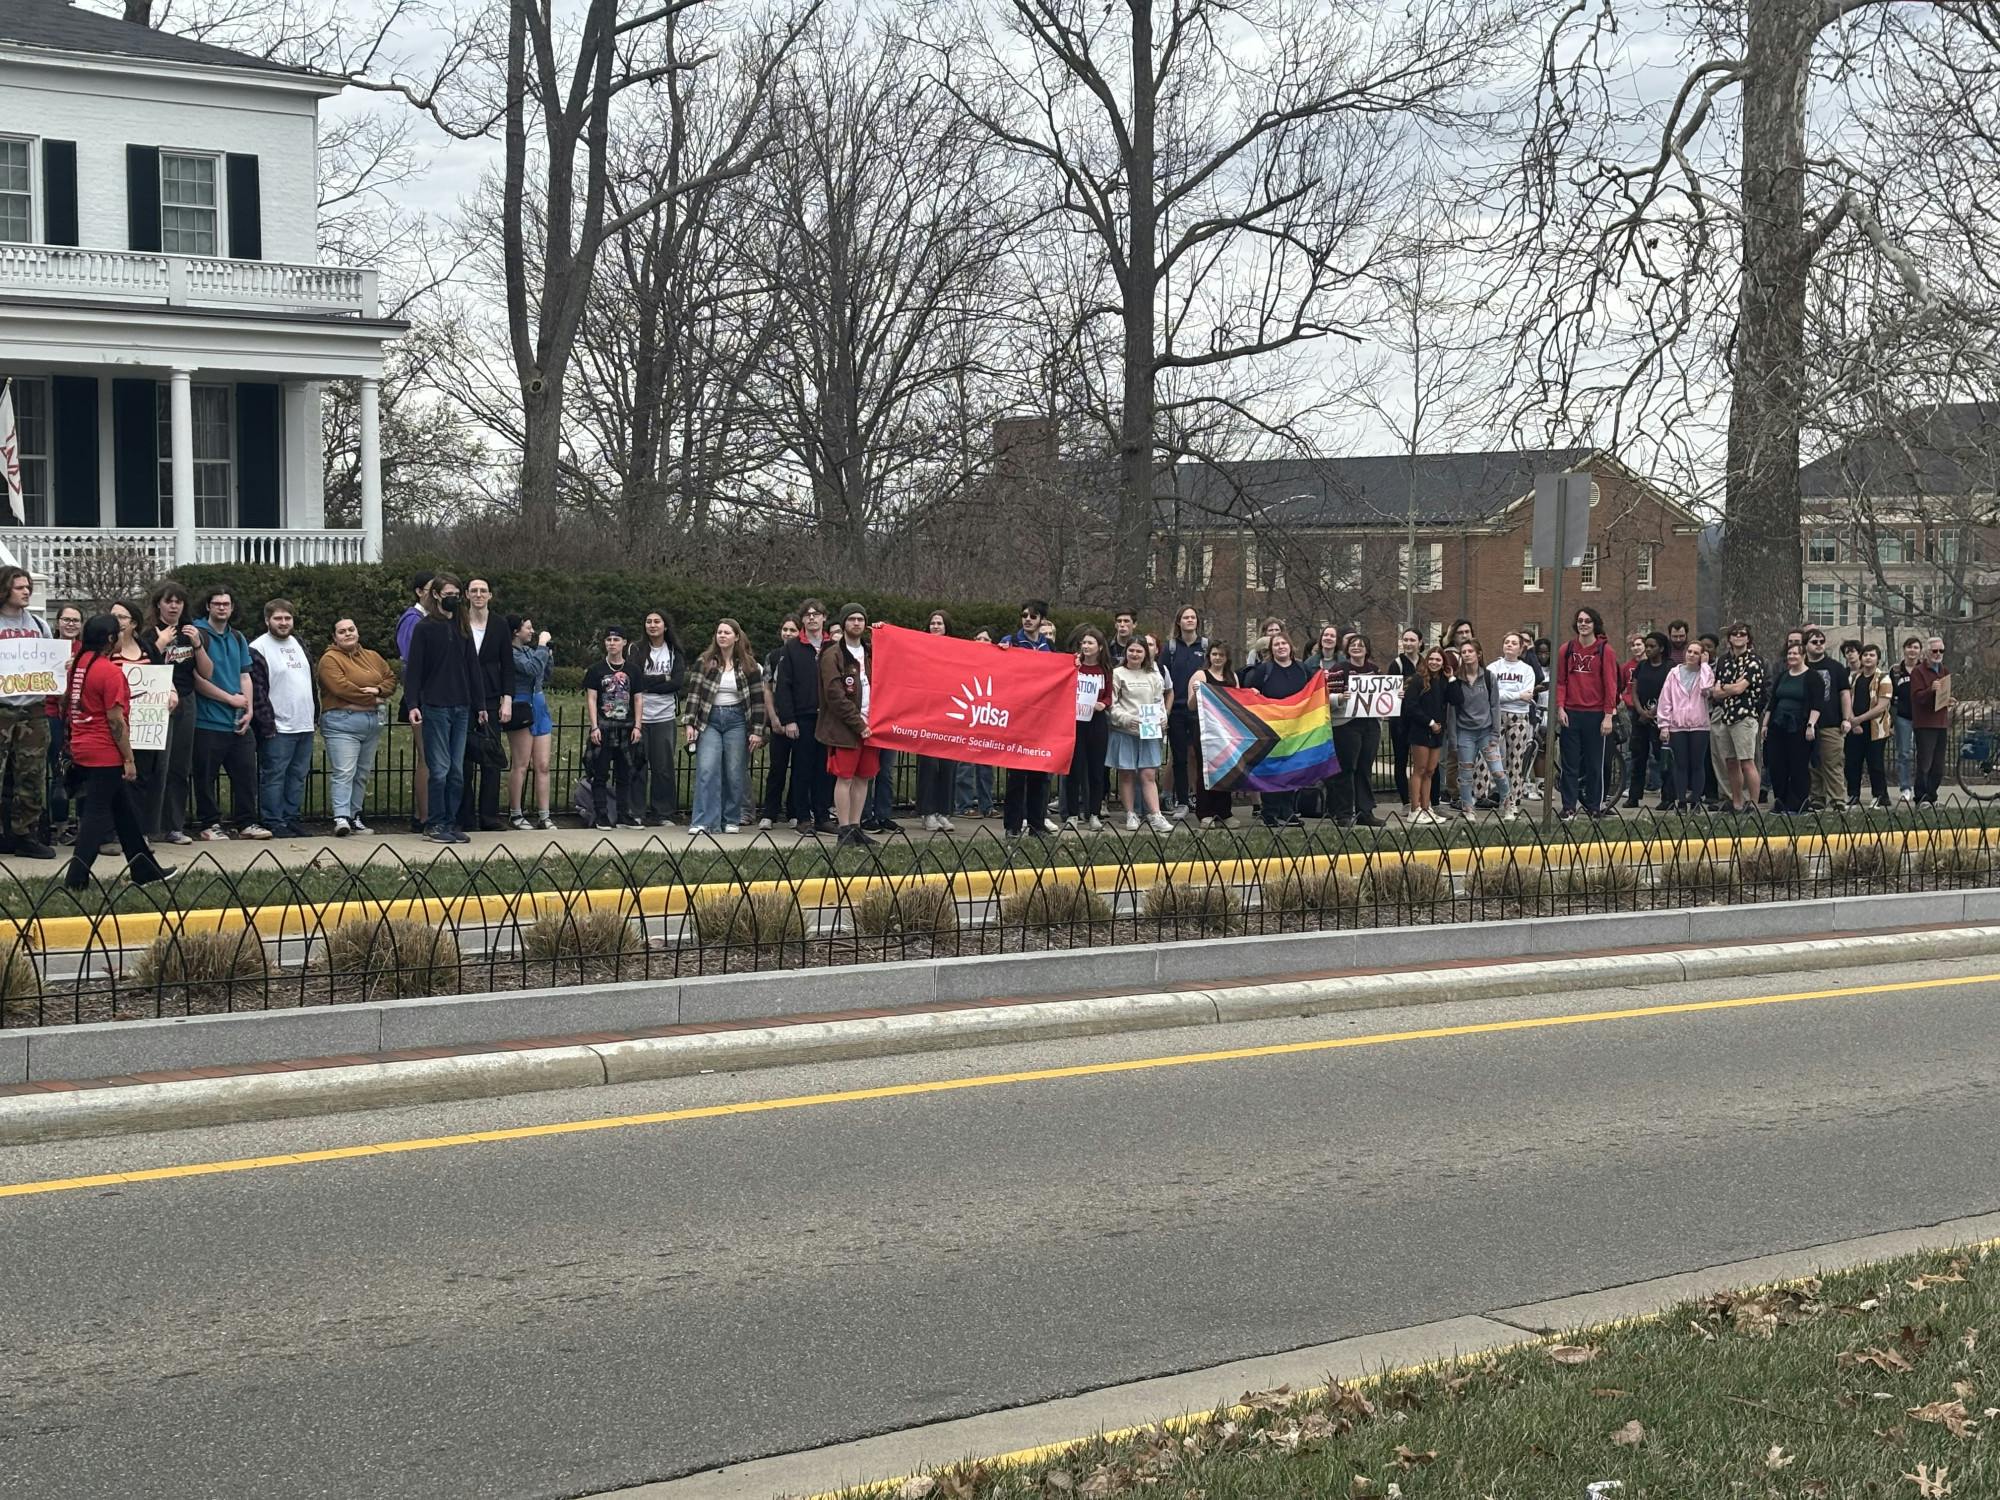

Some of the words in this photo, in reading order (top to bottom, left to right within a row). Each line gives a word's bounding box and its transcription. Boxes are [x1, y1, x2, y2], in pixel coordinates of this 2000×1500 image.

[0, 642, 56, 665] nowledge
[127, 666, 156, 687] Our
[1351, 676, 1386, 693] JUST
[1496, 672, 1523, 683] MIAMI
[131, 691, 169, 704] UDENTS
[130, 708, 166, 722] ESERVE
[969, 702, 1009, 727] ydsa
[130, 724, 164, 745] ETTER
[891, 725, 918, 739] Young
[920, 729, 966, 744] Democratic
[968, 737, 1005, 751] Socialists
[1007, 743, 1016, 752] of
[1016, 745, 1052, 757] America
